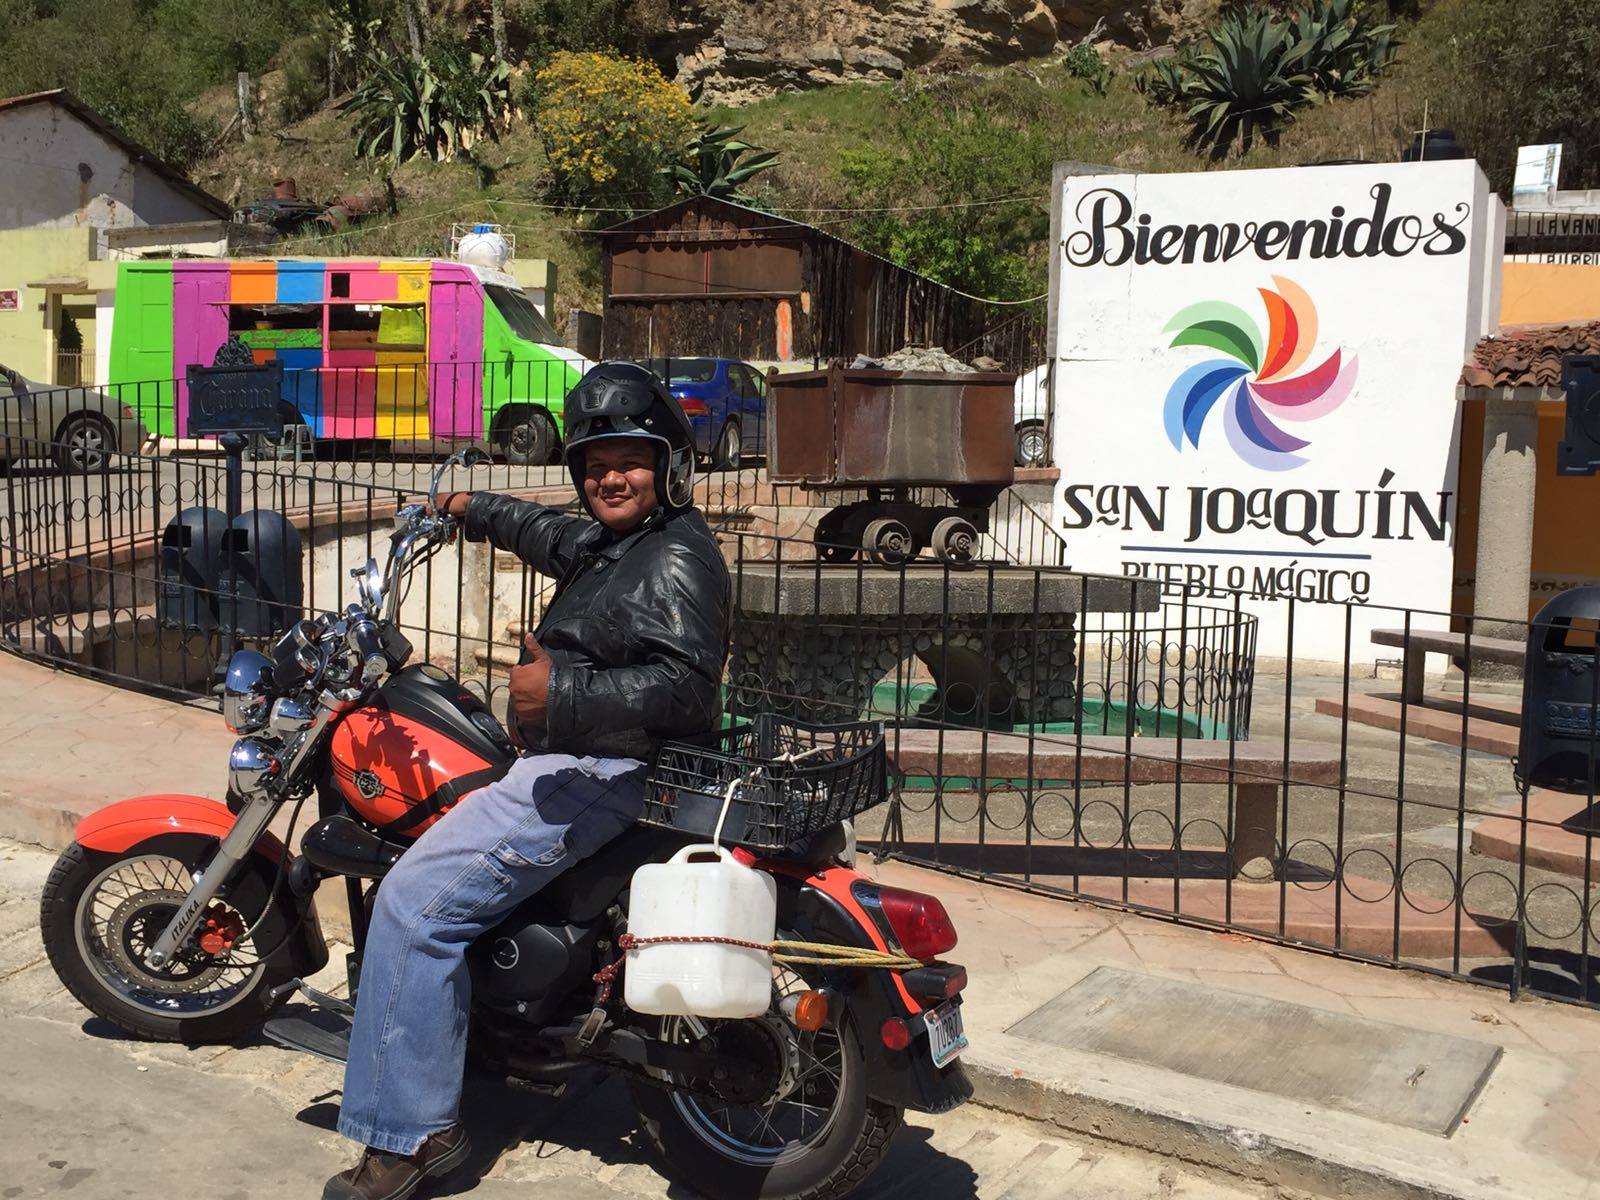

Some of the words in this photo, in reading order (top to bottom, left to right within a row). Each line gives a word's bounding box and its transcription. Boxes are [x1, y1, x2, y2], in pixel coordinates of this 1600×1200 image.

[1064, 183, 1470, 268] Bienvenidos
[1537, 219, 1600, 235] LAVAN
[171, 899, 200, 941] ITALIKA
